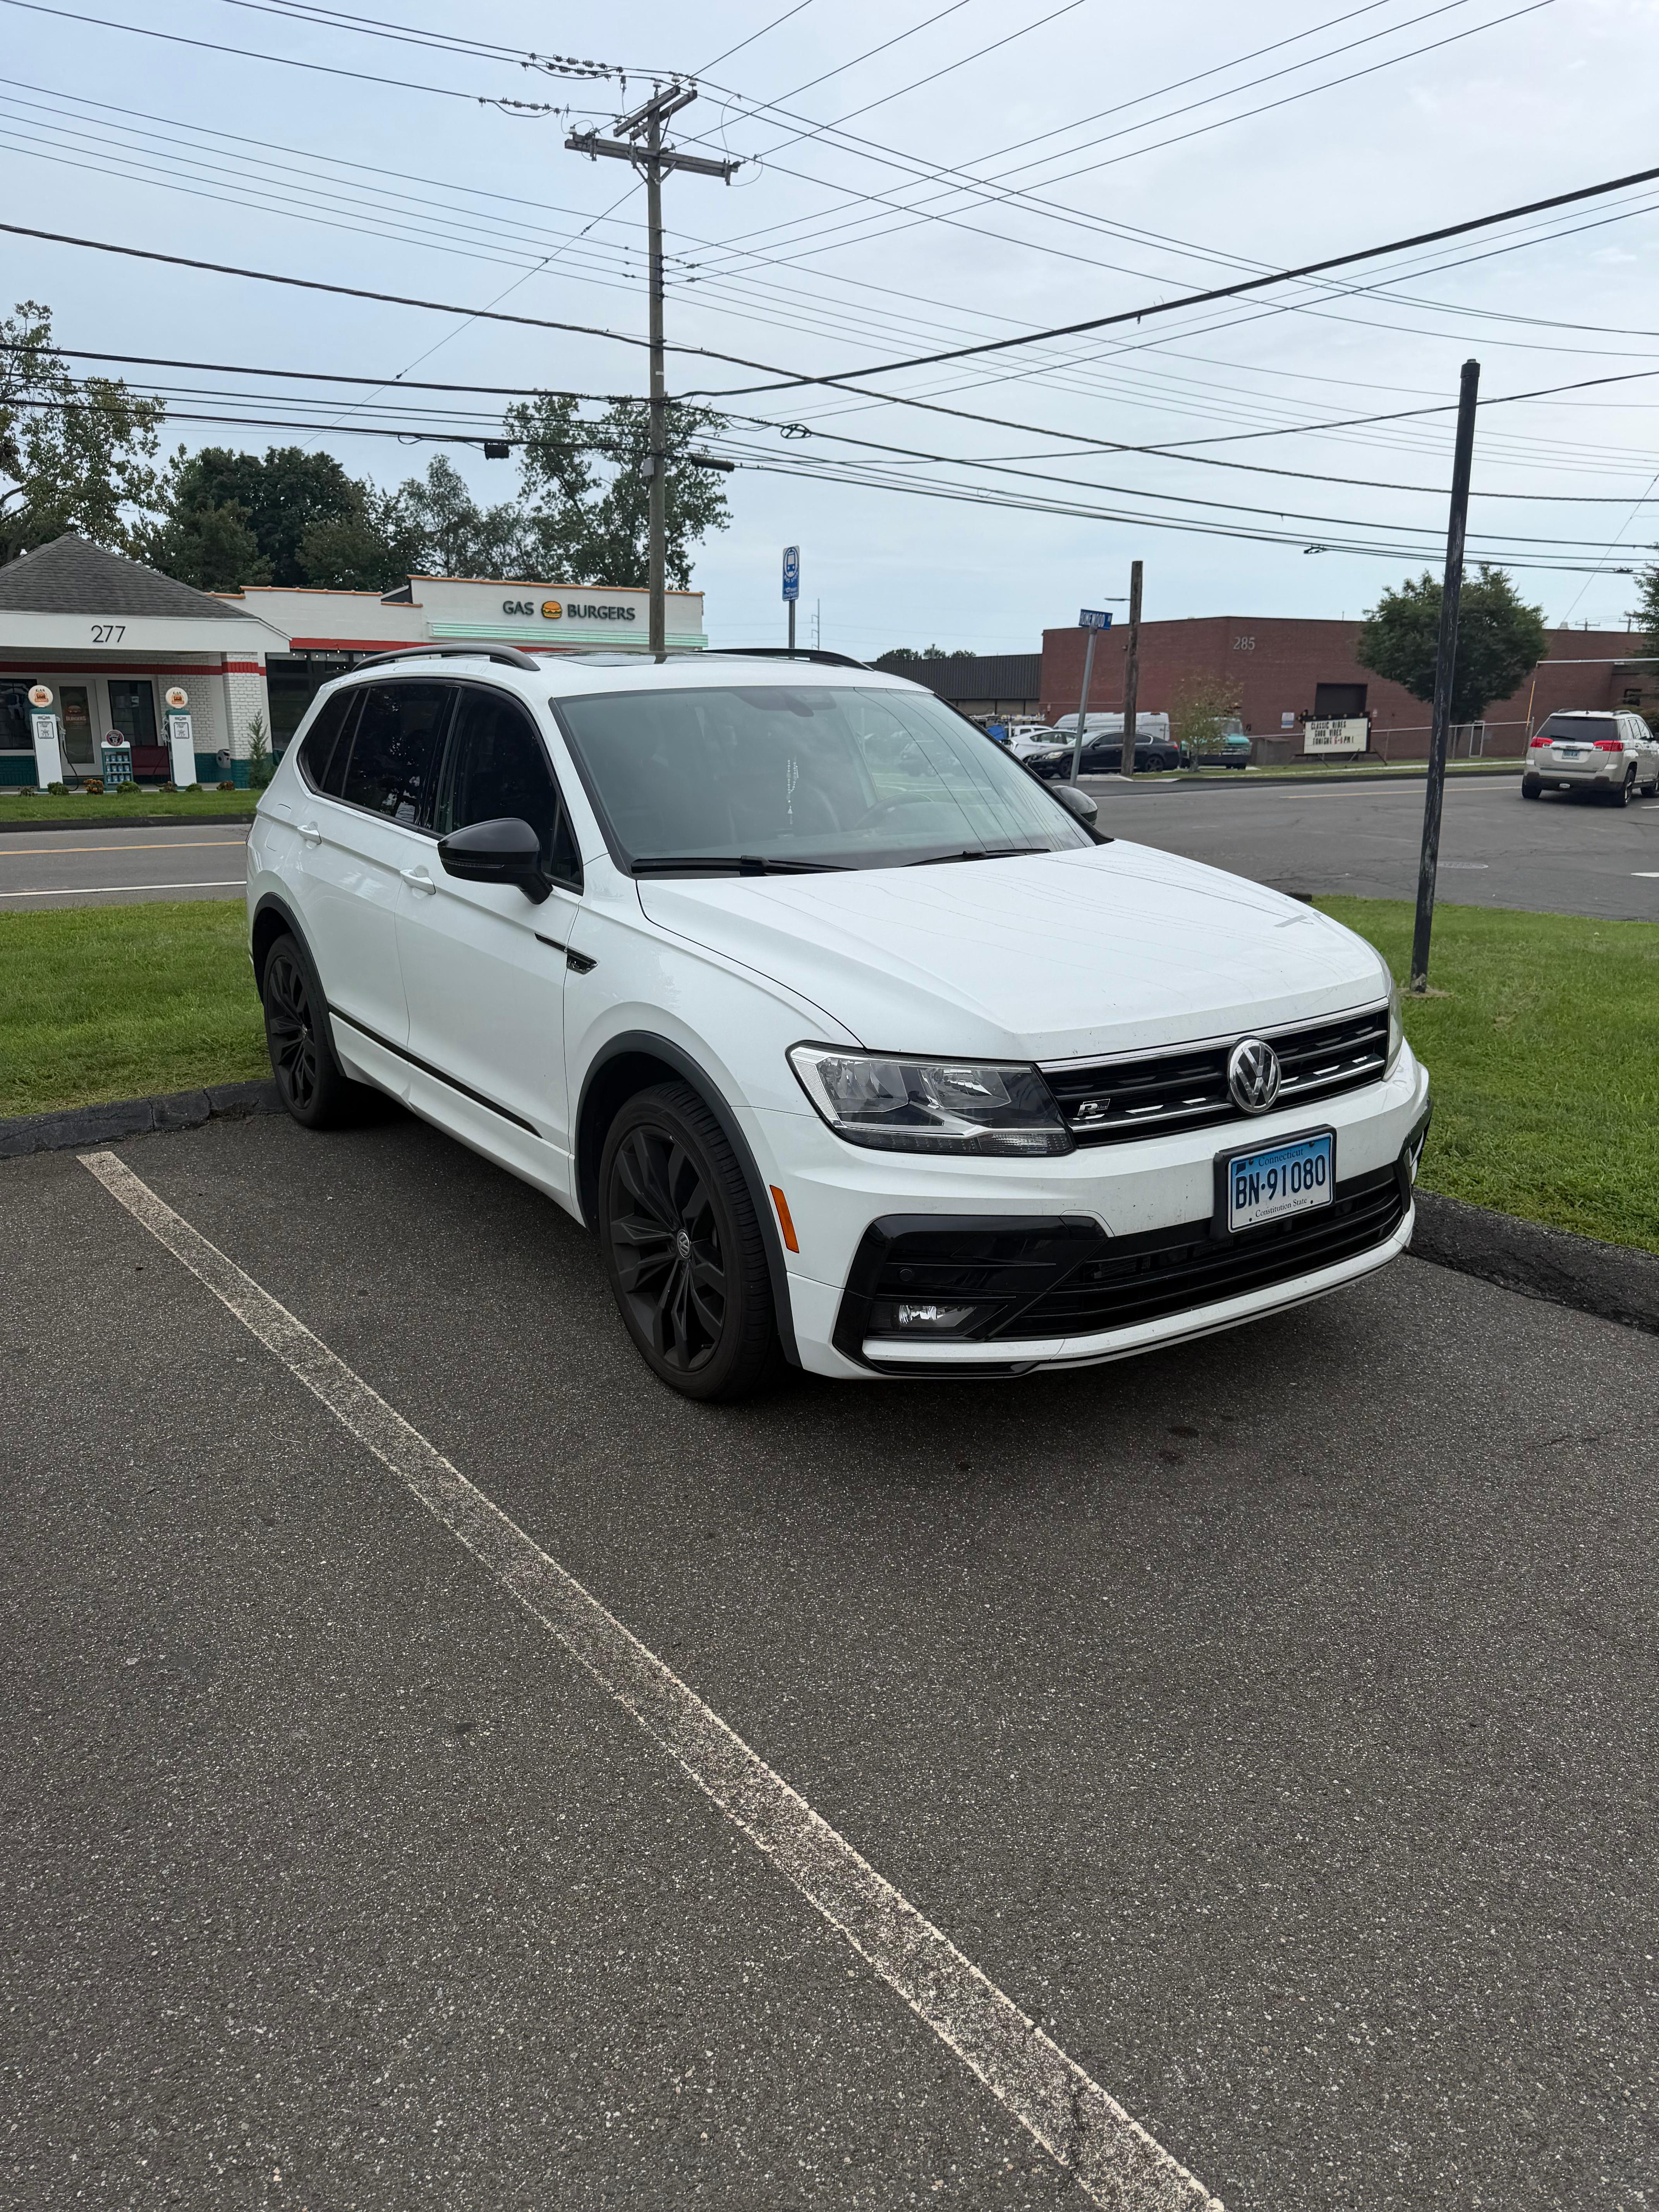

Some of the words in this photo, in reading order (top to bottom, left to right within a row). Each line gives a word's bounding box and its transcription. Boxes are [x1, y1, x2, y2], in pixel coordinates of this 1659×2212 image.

[503, 601, 534, 615] GAS
[567, 604, 636, 620] BURGERS
[91, 625, 126, 642] 277
[1233, 637, 1255, 650] 285
[1311, 722, 1329, 730] CLASSIC
[1259, 1148, 1304, 1166] Connecticut
[1255, 1202, 1291, 1218] Constitution
[1293, 1198, 1307, 1207] State
